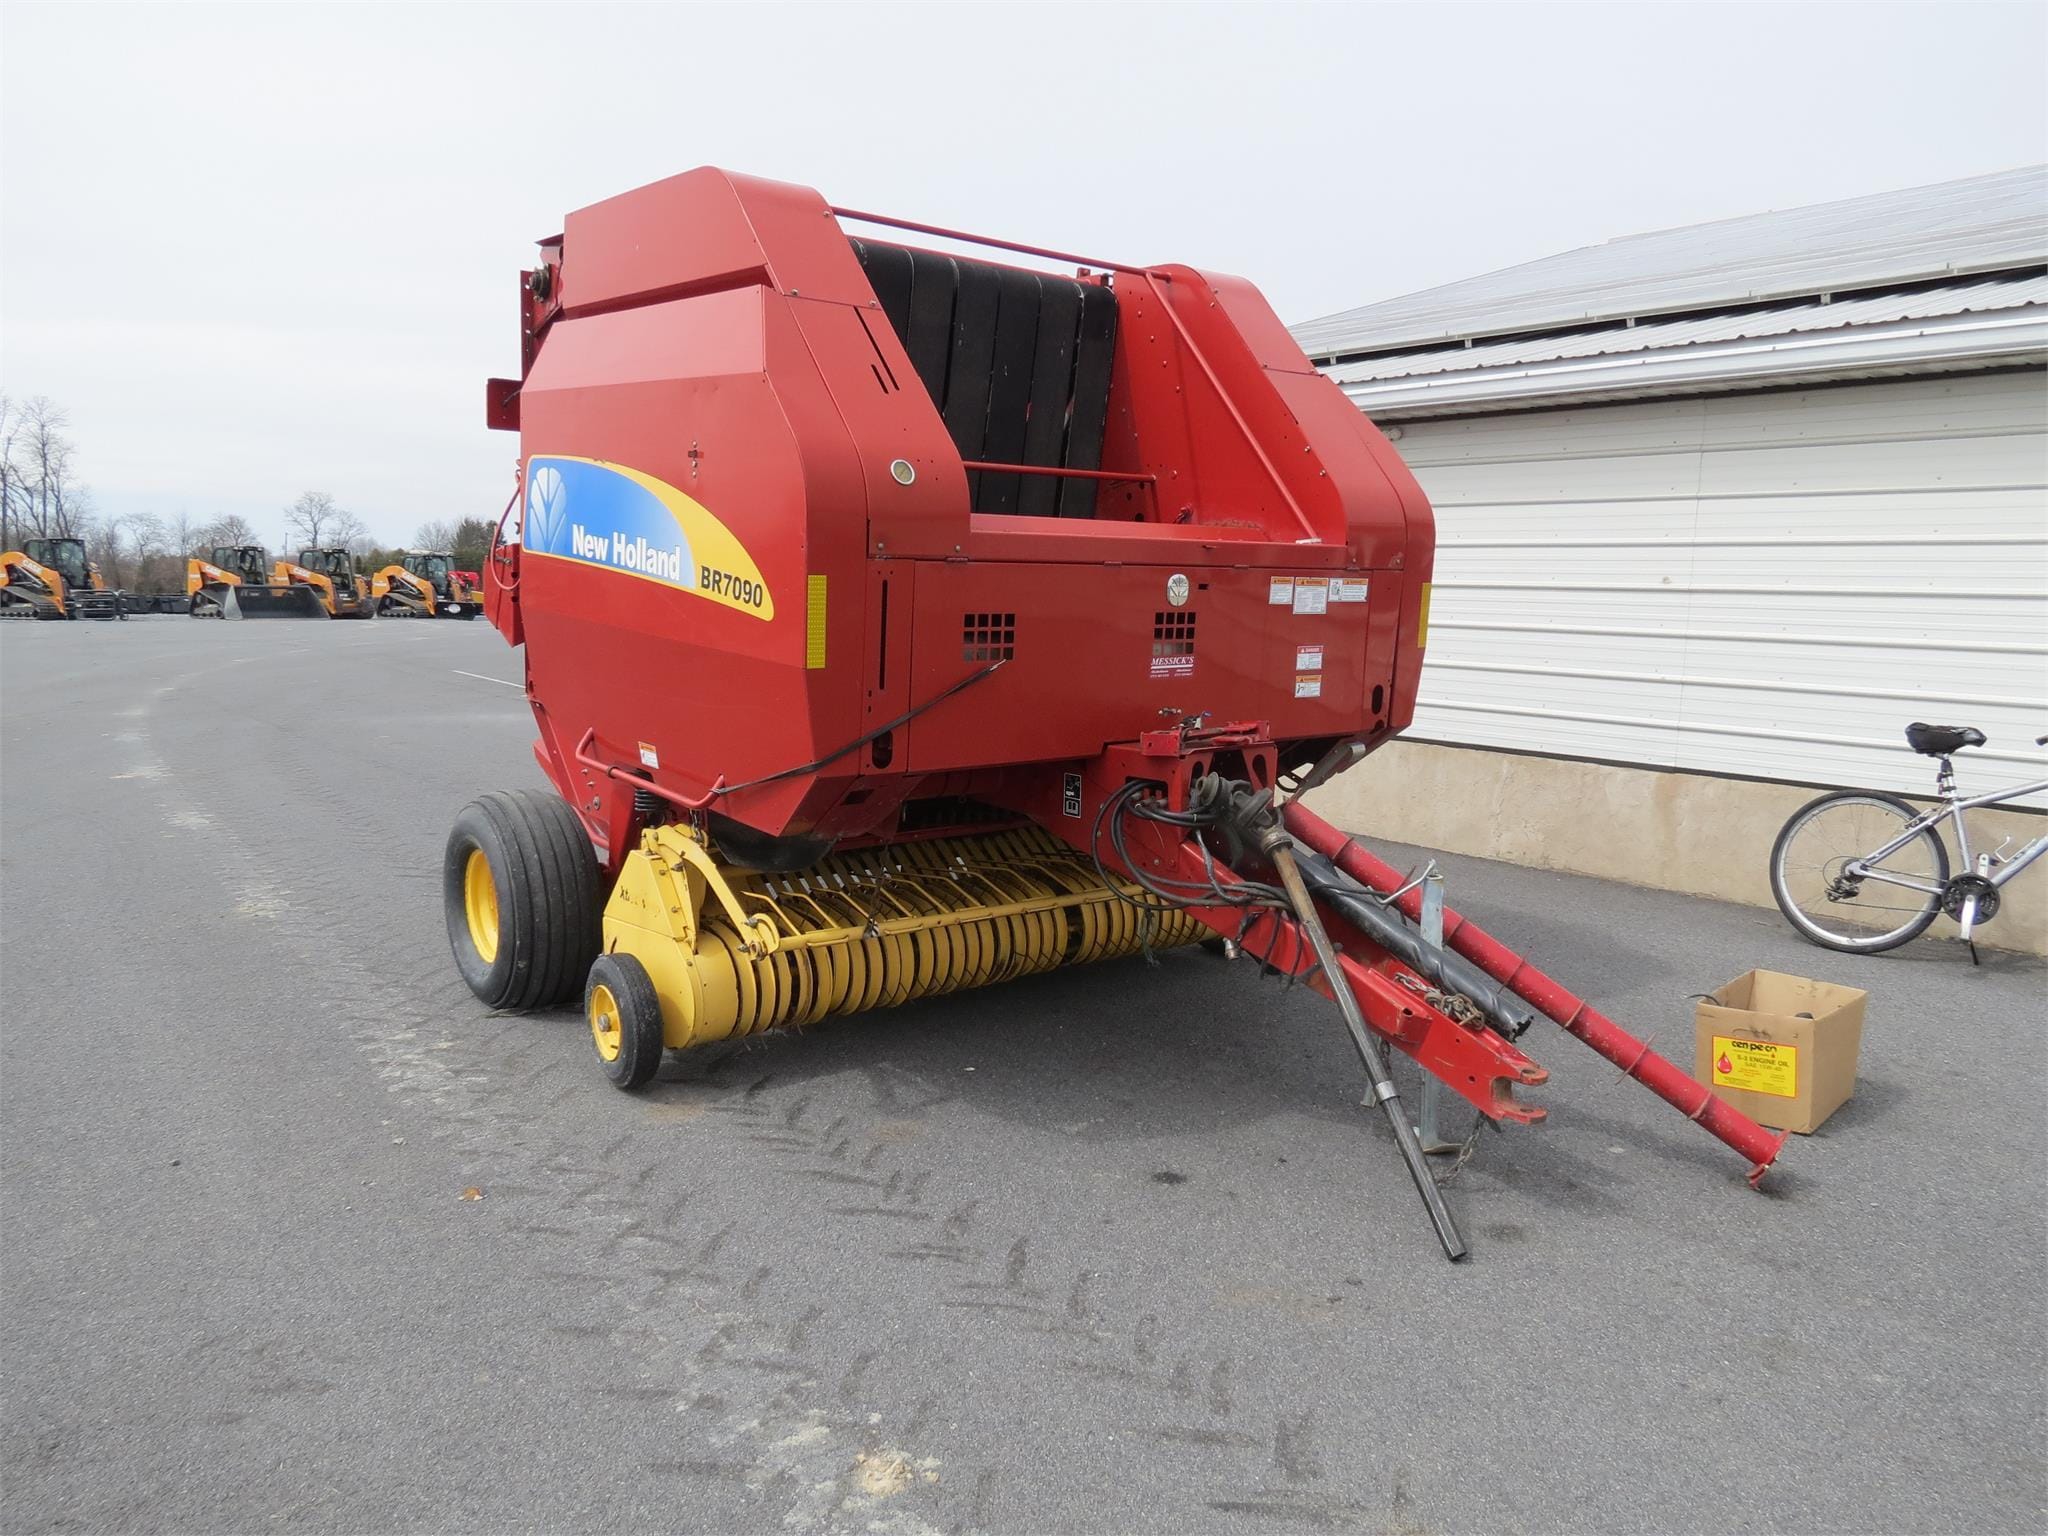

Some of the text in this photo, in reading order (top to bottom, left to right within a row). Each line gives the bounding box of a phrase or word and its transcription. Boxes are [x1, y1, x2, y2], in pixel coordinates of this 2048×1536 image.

[572, 523, 680, 581] New Holland
[701, 565, 763, 608] BR7090
[1151, 656, 1195, 665] MESSICK'S
